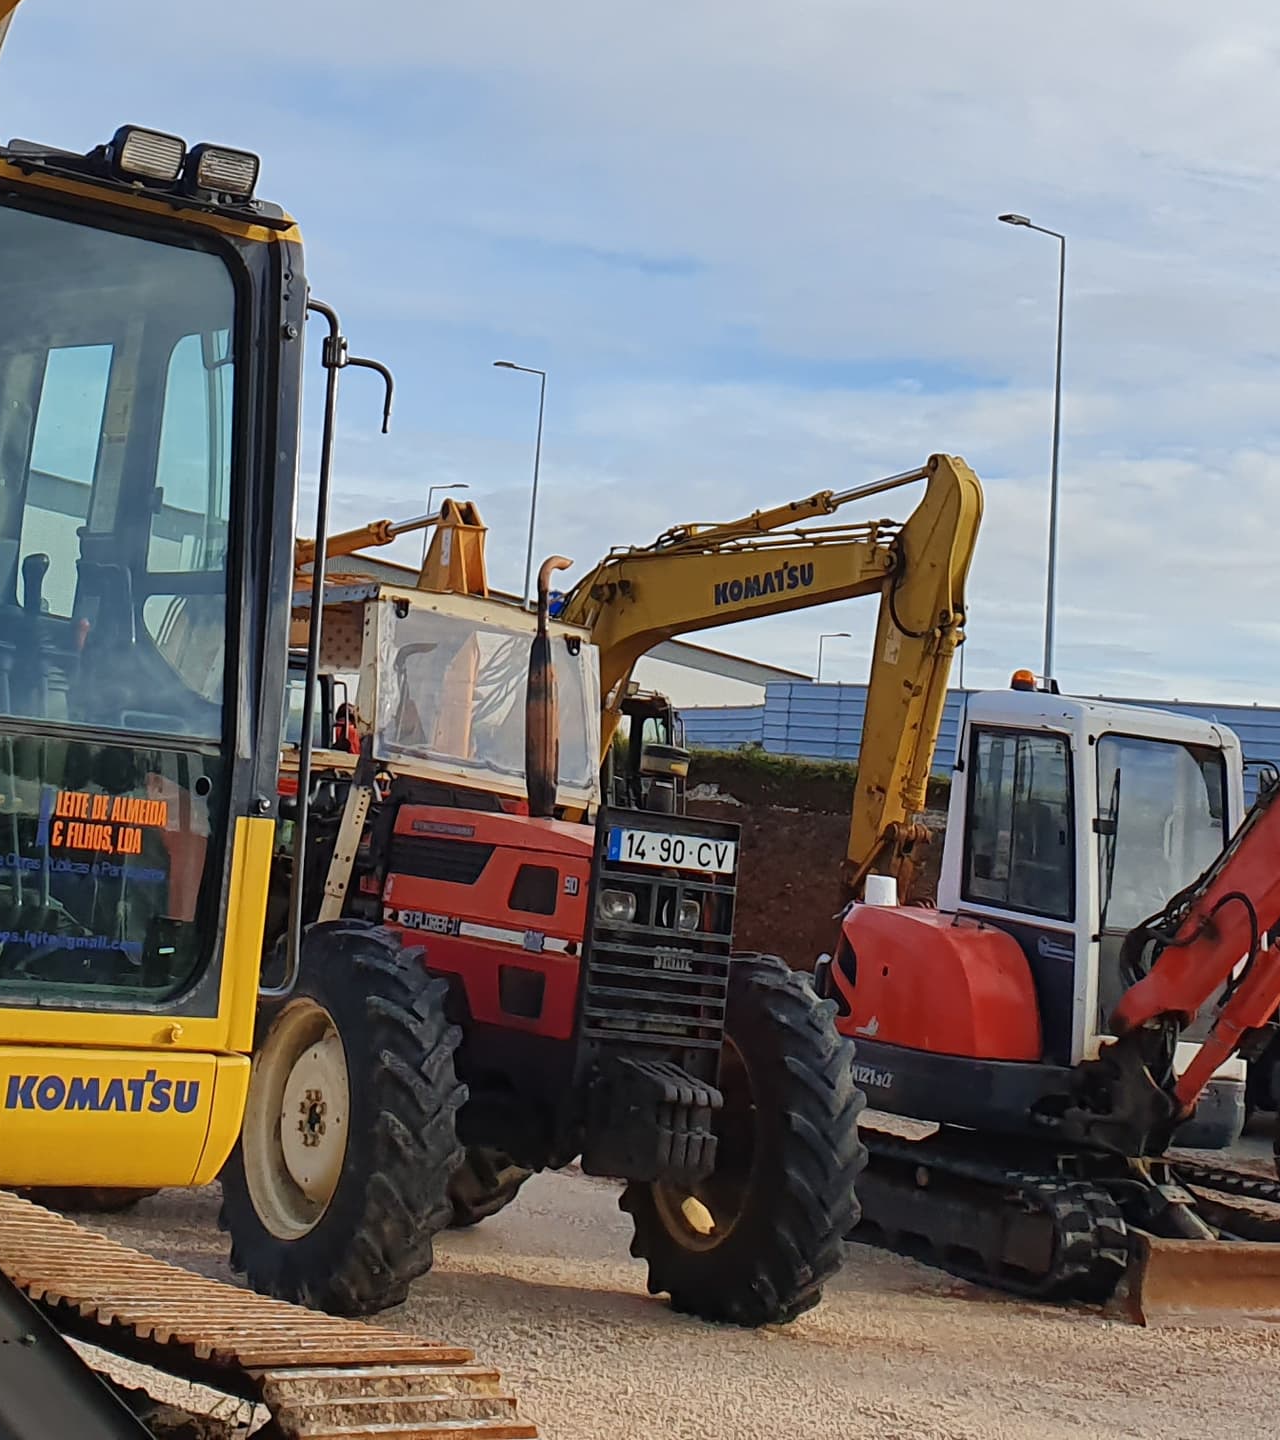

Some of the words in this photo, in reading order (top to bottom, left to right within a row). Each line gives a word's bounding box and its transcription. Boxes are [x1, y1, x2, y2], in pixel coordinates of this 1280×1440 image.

[714, 561, 814, 605] KOMATSU
[56, 791, 89, 818] LEITE
[92, 795, 110, 820] DE
[111, 796, 167, 827] ALMEIDA
[117, 827, 142, 854] LDA
[5, 1070, 200, 1113] KOMATSU
